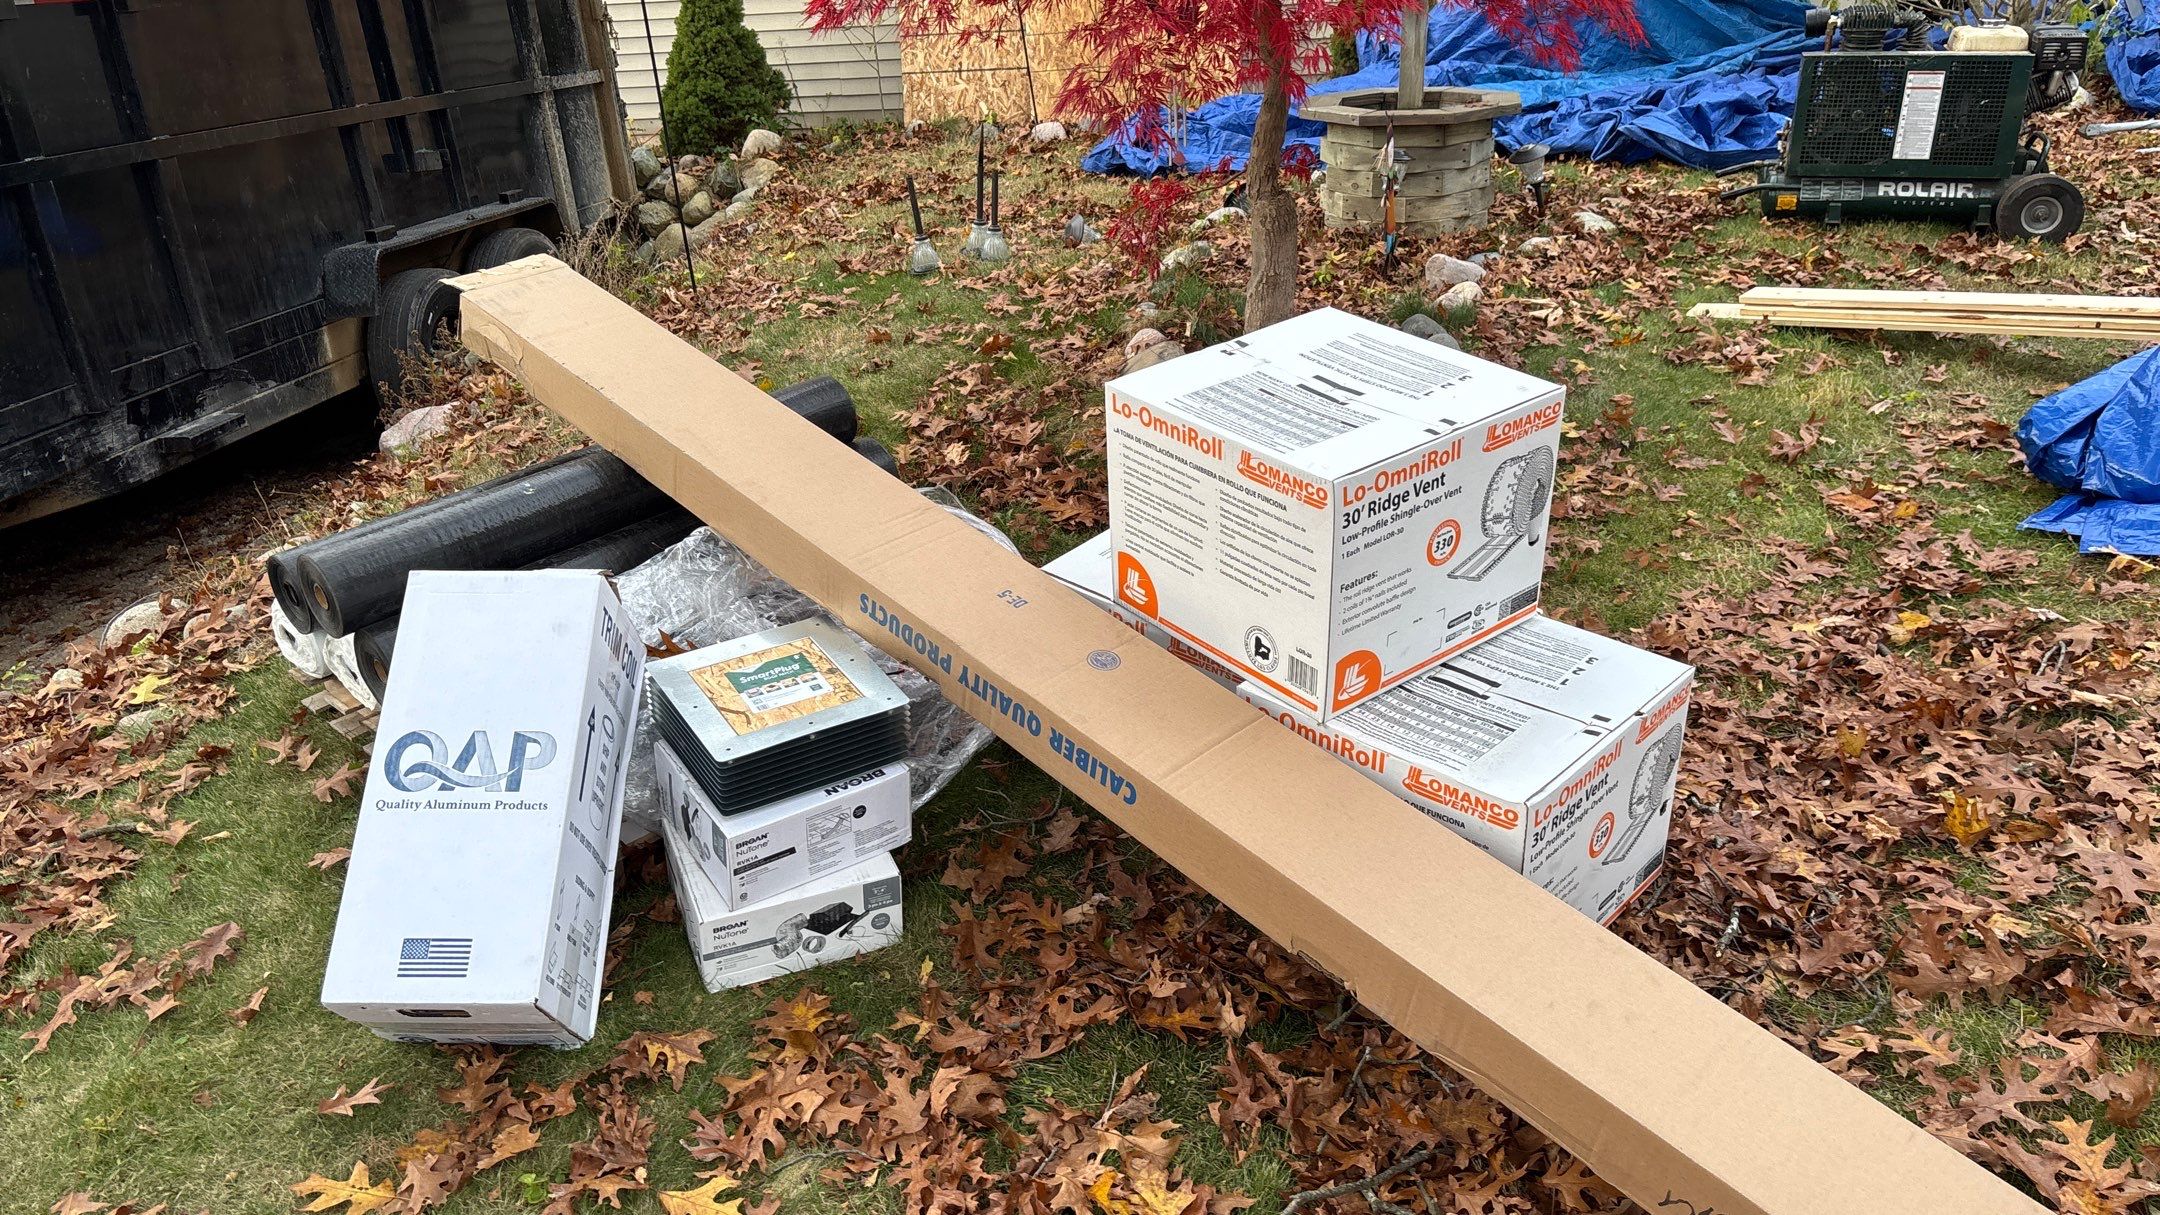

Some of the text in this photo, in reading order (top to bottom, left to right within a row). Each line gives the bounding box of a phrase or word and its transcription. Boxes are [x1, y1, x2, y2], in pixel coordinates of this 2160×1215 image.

[1878, 181, 1974, 198] ROLAIR
[1437, 381, 1456, 389] 2
[1111, 392, 1223, 461] Lo-OmniRoll
[1487, 401, 1561, 441] LOMANCO
[1512, 423, 1540, 442] VENTS
[1174, 453, 1188, 466] PARA
[1217, 473, 1225, 483] EN
[1226, 477, 1243, 492] ROLLO
[1244, 485, 1256, 499] QUE
[1257, 491, 1287, 512] FUNCIONA
[1241, 450, 1328, 502] LOMANCO
[1341, 436, 1463, 510] Lo-OmniRoll
[1269, 478, 1303, 502] VENTS
[1367, 483, 1410, 522] Ridge
[1412, 468, 1446, 499] Vent
[1341, 483, 1462, 547] Low-Profile Shingle-Over Vent
[1341, 525, 1404, 560] 1 Each Model LOR-30
[1433, 533, 1454, 554] 330
[1339, 567, 1378, 594] Features:
[997, 589, 1028, 609] DE-5
[601, 605, 623, 661] TRIM
[621, 642, 637, 690] COIL
[1484, 663, 1508, 673] STEPS
[1569, 666, 1587, 675] 2
[1582, 655, 1600, 665] 3
[740, 663, 800, 684] SmartPlug
[1558, 677, 1573, 686] 1
[859, 593, 1138, 807] CALIBER QUALITY PRODUCTS
[1245, 696, 1385, 774] OmniRoll
[384, 730, 557, 793] QAP
[824, 768, 887, 797] BROAN
[1409, 765, 1520, 822] LOMANCO
[1534, 738, 1623, 828] Lo-OmniRoll
[375, 799, 548, 812] Quality Aluminum Products
[1443, 796, 1488, 821] VENTS
[1551, 798, 1583, 832] Ridge
[1585, 772, 1609, 800] Vent
[1427, 807, 1466, 830] FUNCIONA
[1530, 827, 1566, 863] Low-Profile
[1566, 793, 1605, 832] Shingle-Over
[735, 832, 767, 850] BROAN
[736, 841, 768, 858] NuTone
[736, 855, 759, 867] RVK1A
[713, 920, 747, 934] BROAN
[713, 929, 748, 941] NuTone
[713, 941, 737, 951] RVK1A
